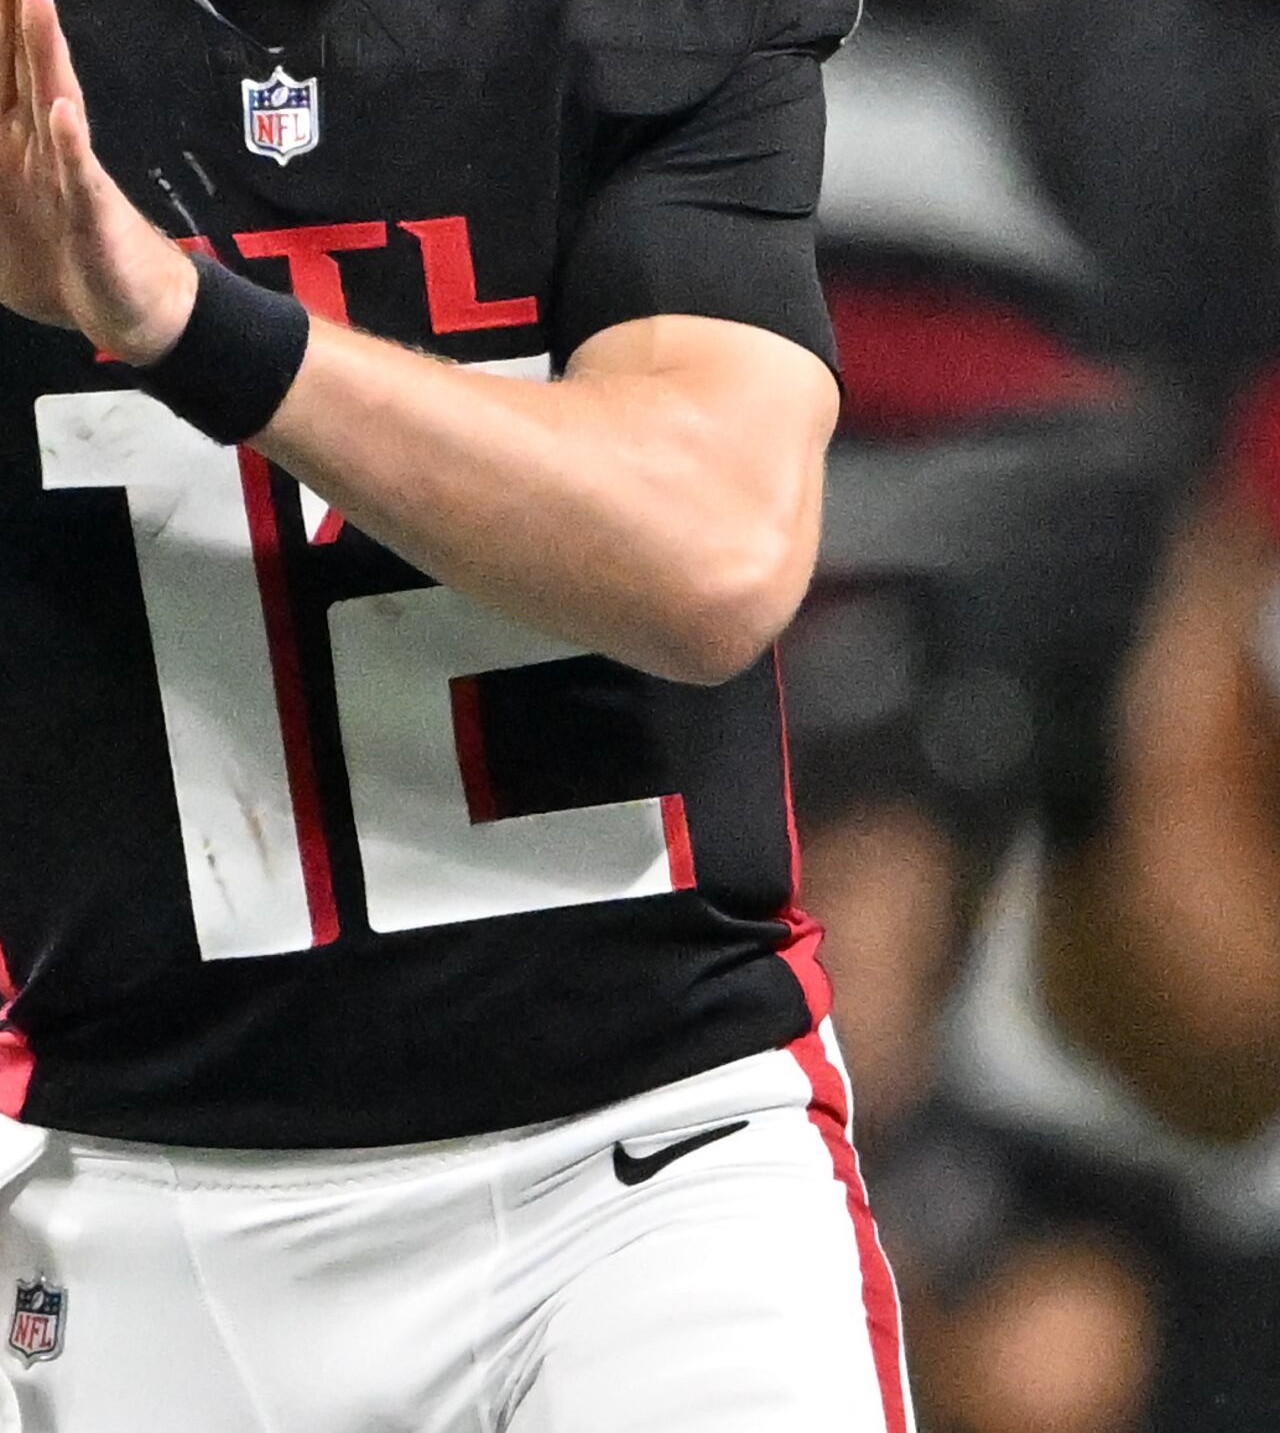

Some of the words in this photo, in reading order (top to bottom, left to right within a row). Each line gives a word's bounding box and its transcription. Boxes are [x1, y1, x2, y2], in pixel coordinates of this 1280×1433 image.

[255, 112, 307, 148] NFL
[95, 216, 539, 364] TL
[14, 1314, 53, 1350] NFL
